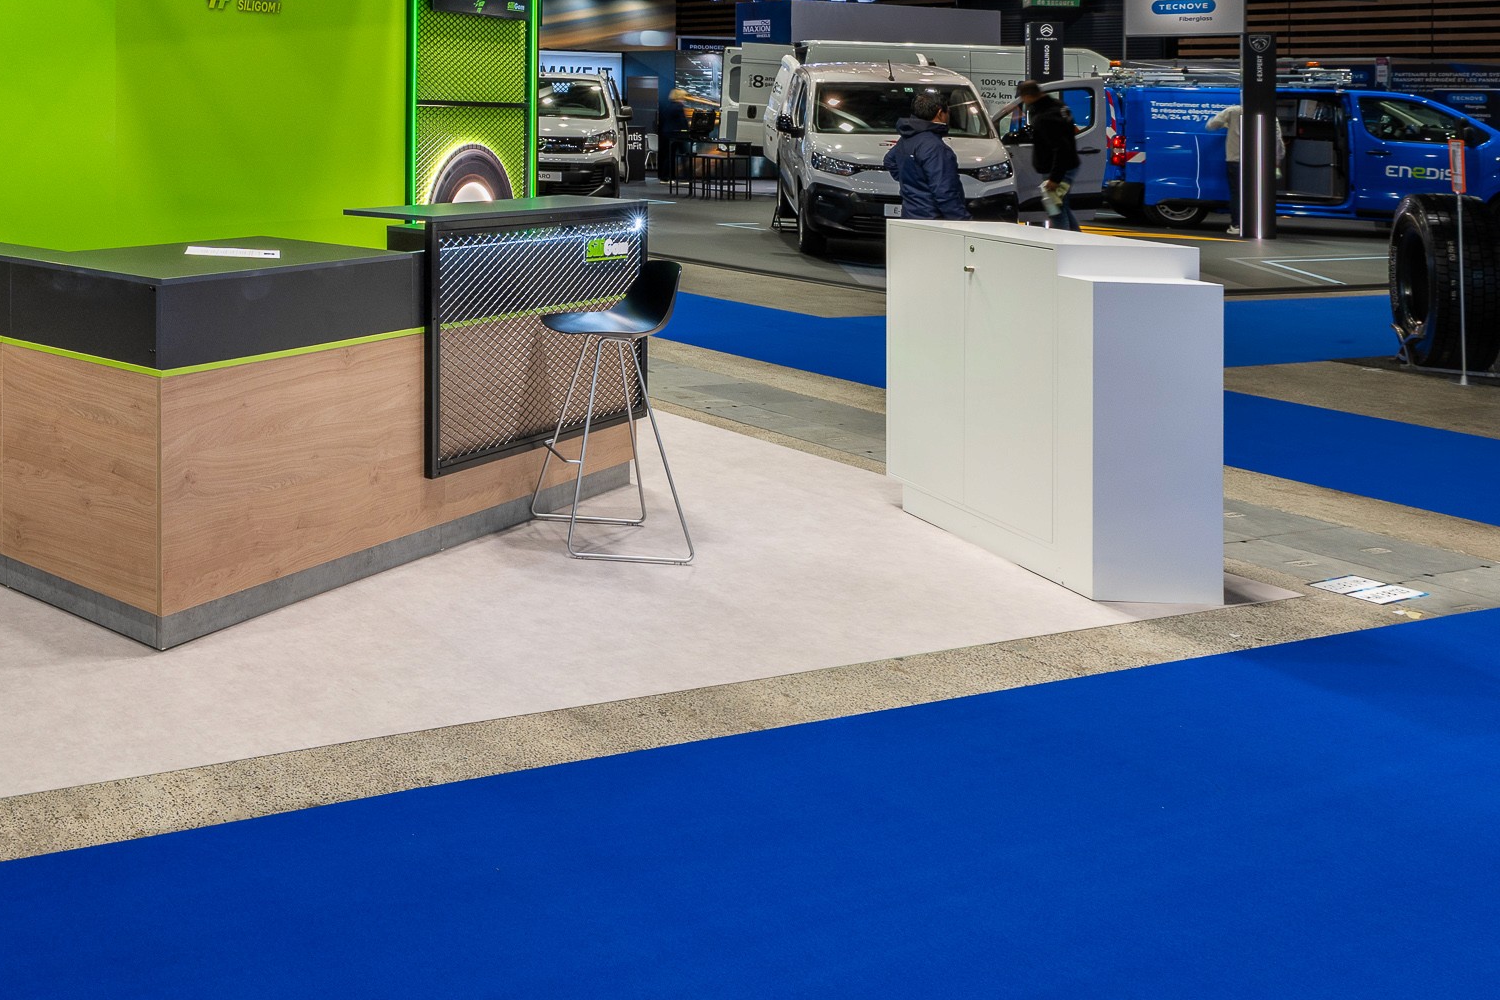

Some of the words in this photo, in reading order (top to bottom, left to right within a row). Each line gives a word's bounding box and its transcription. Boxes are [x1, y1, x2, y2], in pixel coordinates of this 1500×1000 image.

[238, 0, 276, 12] SILIGOM
[743, 25, 770, 33] MAXION
[752, 75, 764, 88] 8
[628, 132, 642, 141] ntis
